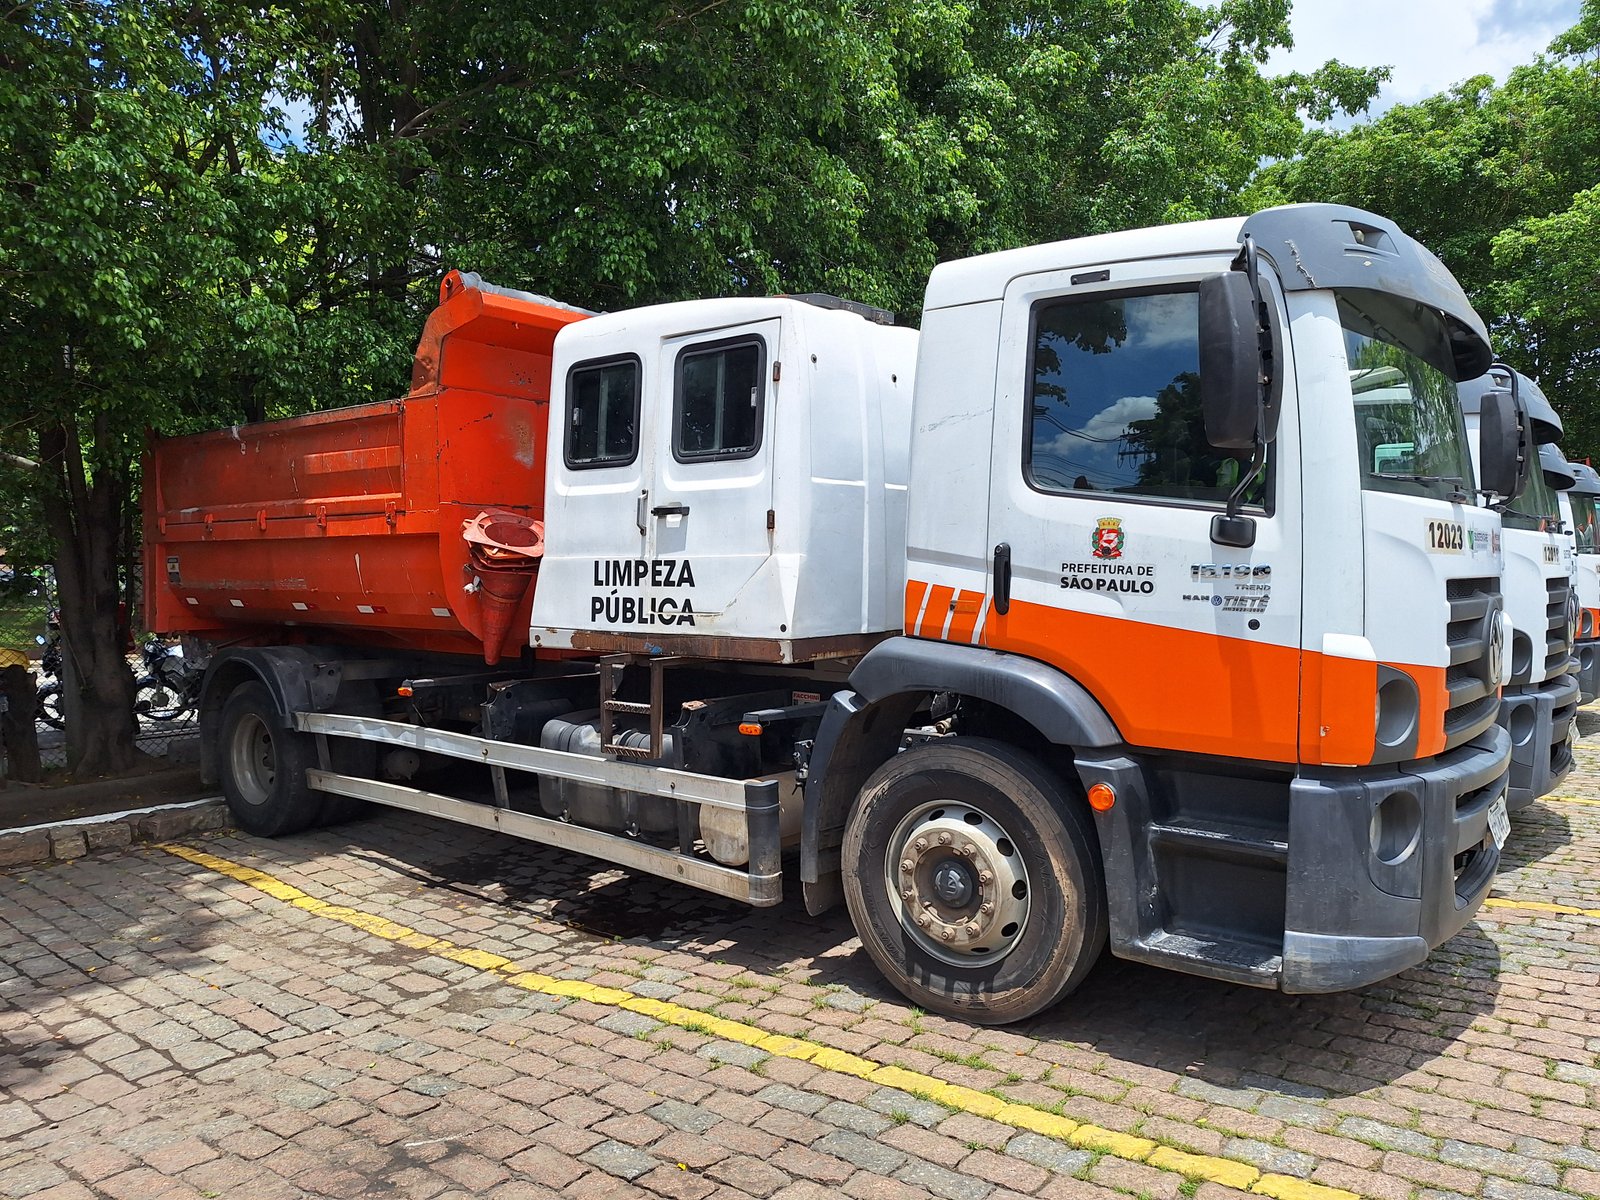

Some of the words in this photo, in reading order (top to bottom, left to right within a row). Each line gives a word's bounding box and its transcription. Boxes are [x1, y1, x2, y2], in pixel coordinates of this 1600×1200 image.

[1428, 521, 1464, 551] 12023
[593, 560, 696, 588] LIMPEZA
[1061, 562, 1134, 576] PREFEITURA
[1137, 566, 1154, 577] DE
[1060, 574, 1094, 590] SÃO
[1096, 579, 1154, 594] PAULO
[1235, 583, 1272, 592] TREND
[590, 588, 696, 627] PÚBLICA
[1182, 594, 1210, 602] MAN
[1223, 593, 1271, 608] TIETÊ
